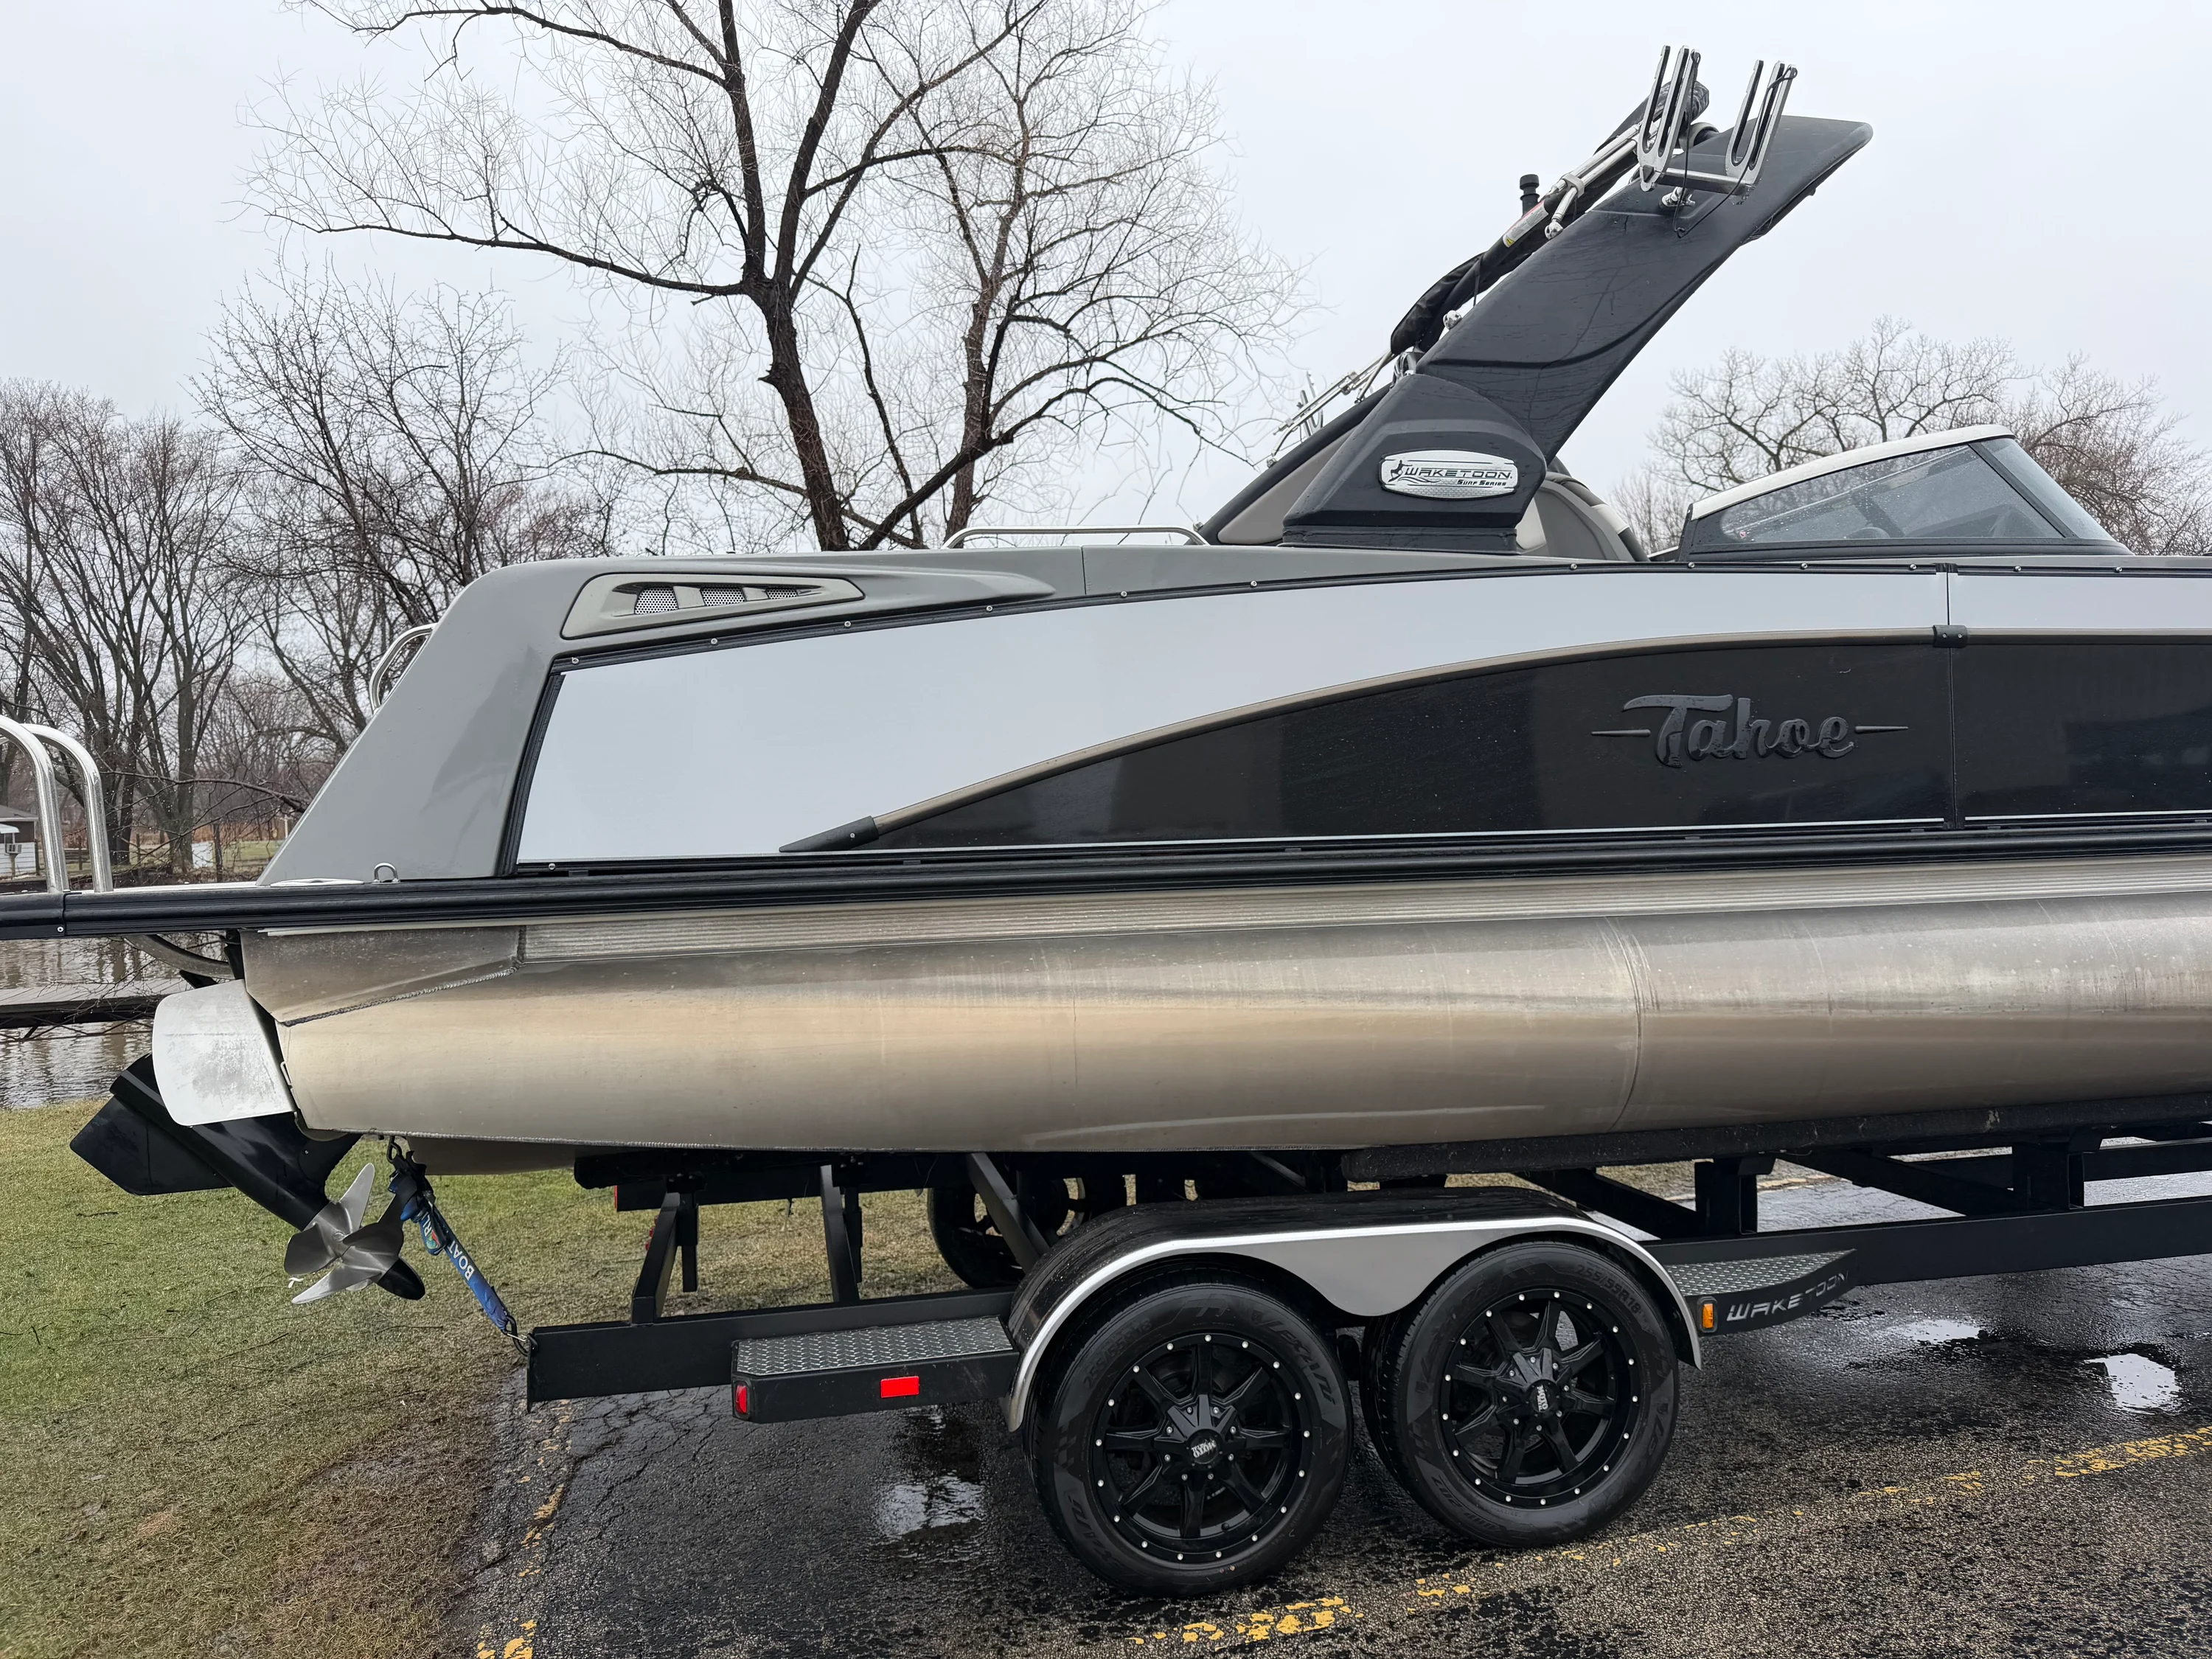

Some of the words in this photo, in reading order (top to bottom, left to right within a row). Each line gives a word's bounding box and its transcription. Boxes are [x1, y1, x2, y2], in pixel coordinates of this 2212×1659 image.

[1622, 693, 1856, 769] Tahoe
[447, 1239, 476, 1281] BOAT
[1725, 1269, 1849, 1322] WAKETOON
